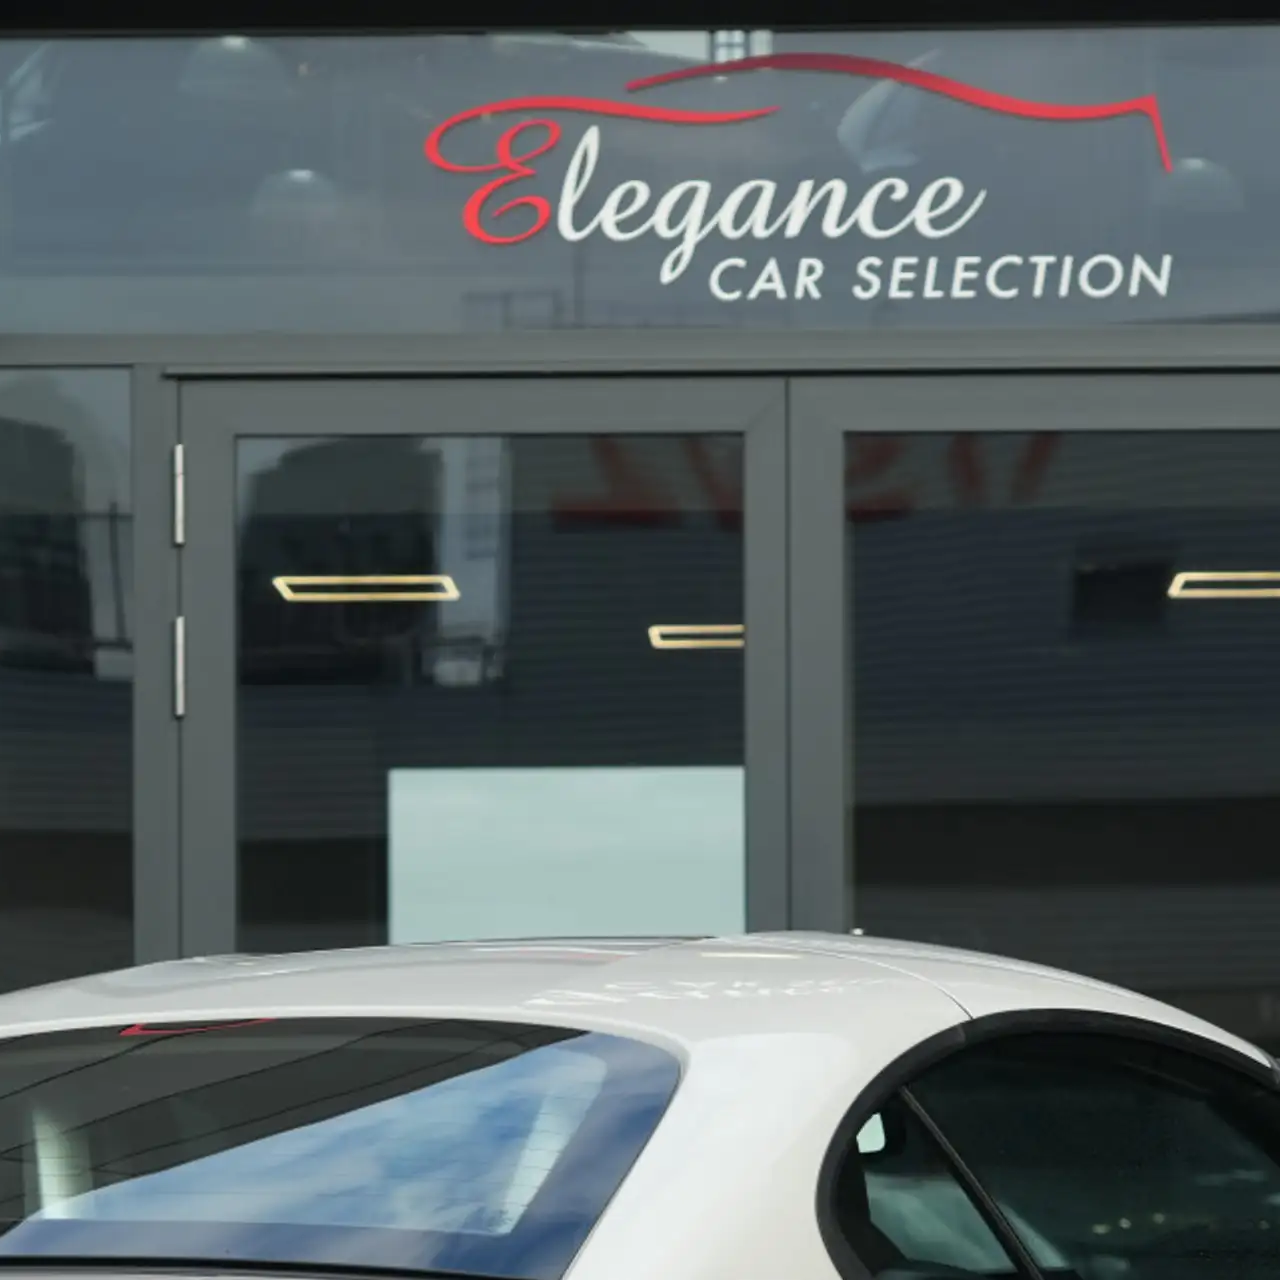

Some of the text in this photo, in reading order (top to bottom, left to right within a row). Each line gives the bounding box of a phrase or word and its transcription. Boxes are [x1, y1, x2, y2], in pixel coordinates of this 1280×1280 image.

[424, 96, 987, 285] Elegance
[708, 253, 1174, 302] CAR SELECTION
